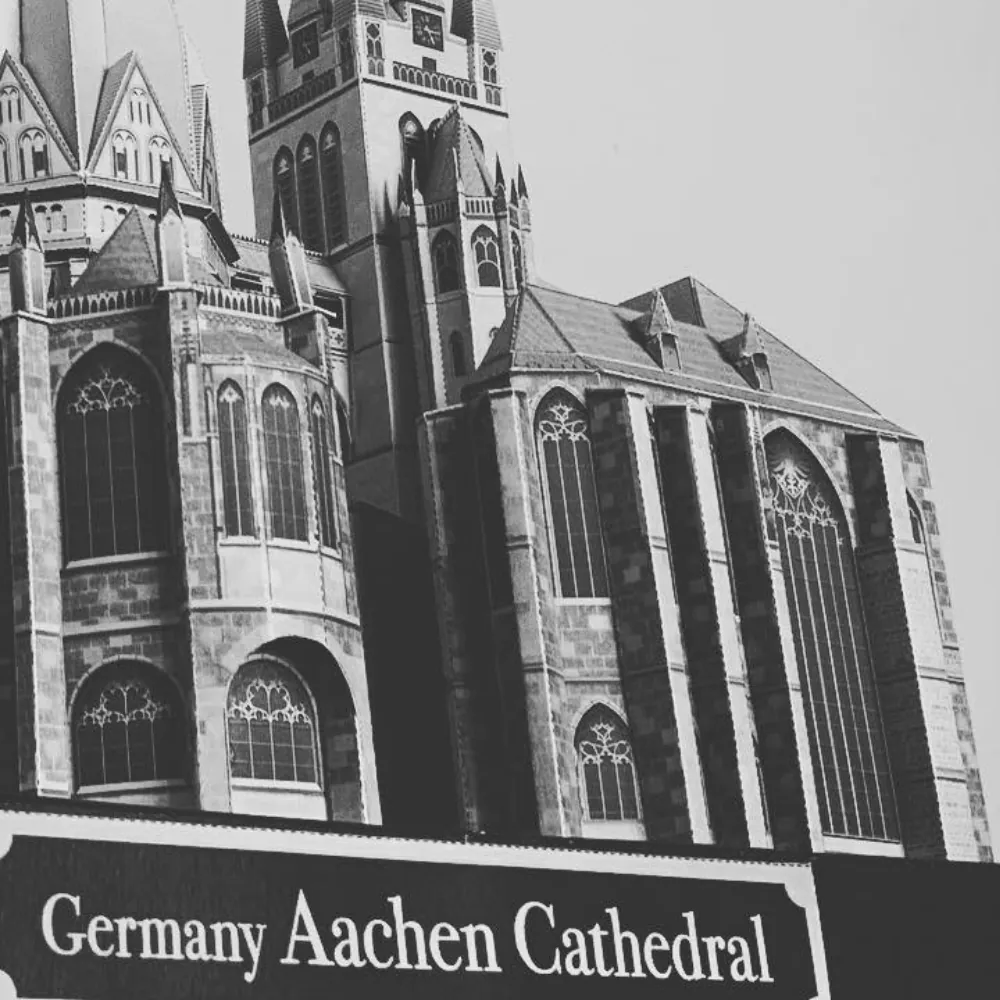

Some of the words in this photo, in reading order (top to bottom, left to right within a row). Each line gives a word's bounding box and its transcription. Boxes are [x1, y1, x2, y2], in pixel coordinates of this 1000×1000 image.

[41, 892, 267, 983] Germany
[280, 888, 503, 973] Aachen
[513, 901, 775, 984] Cathedral
